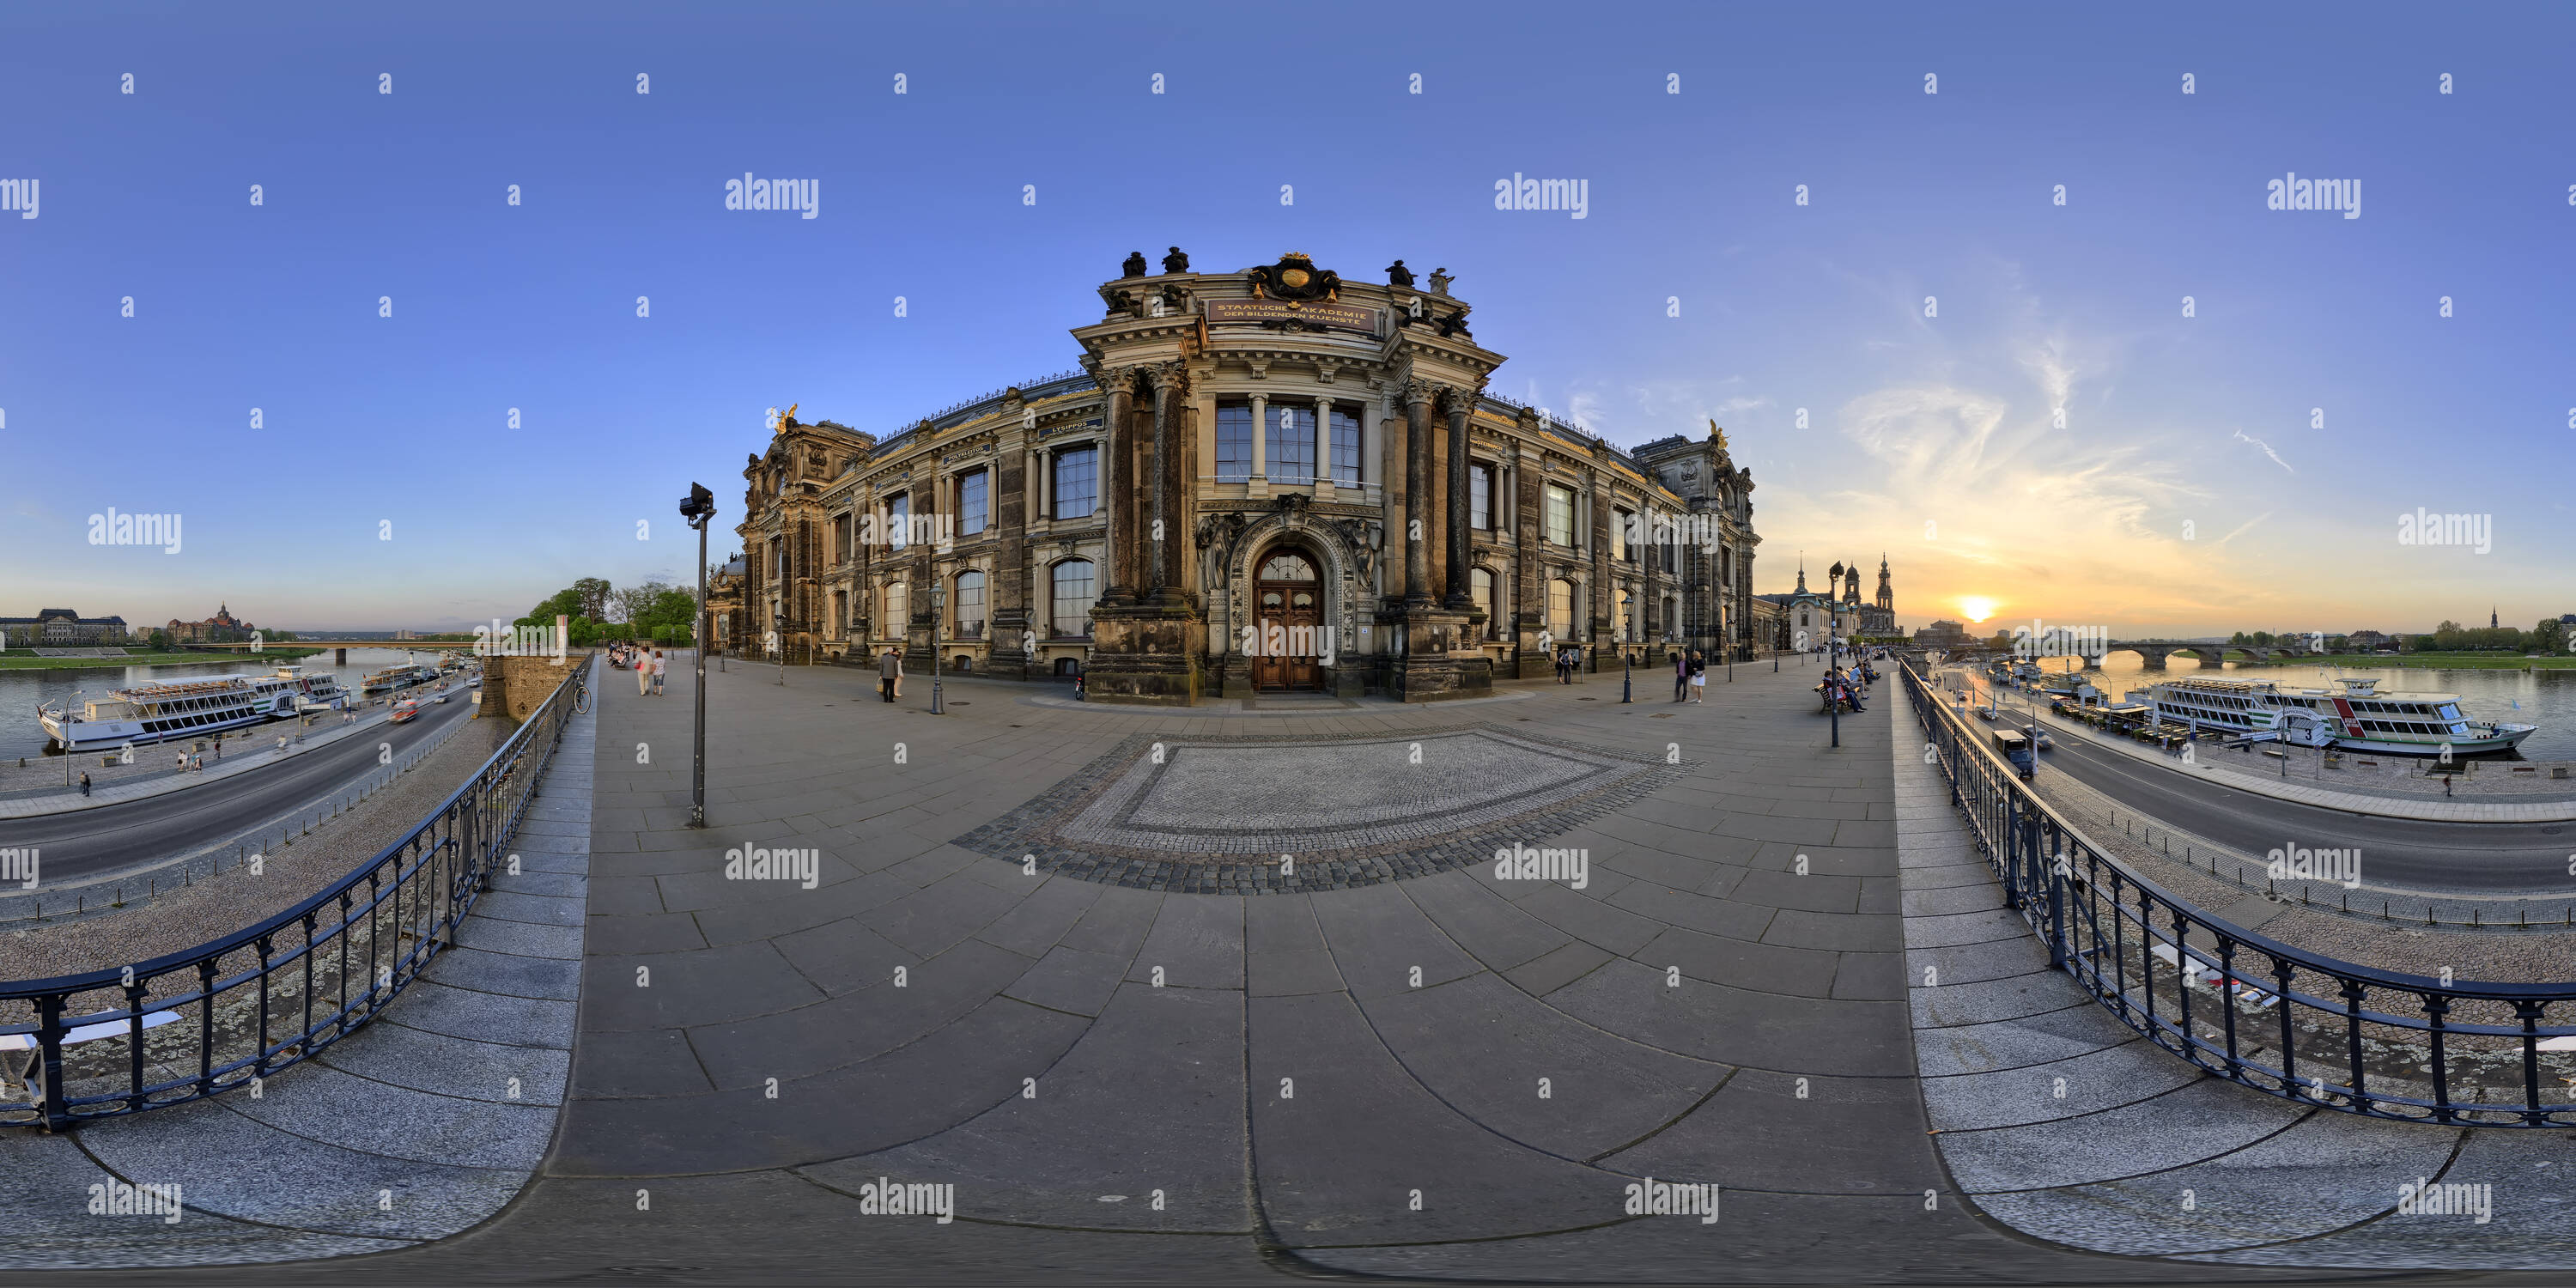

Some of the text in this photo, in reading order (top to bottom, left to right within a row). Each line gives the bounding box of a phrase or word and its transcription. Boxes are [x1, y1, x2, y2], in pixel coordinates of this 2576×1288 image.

[1300, 307, 1367, 319] AKADEMIE
[1309, 313, 1361, 325] KUENSTE
[1052, 422, 1088, 433] LYSIPPOS
[2305, 728, 2312, 741] 3
